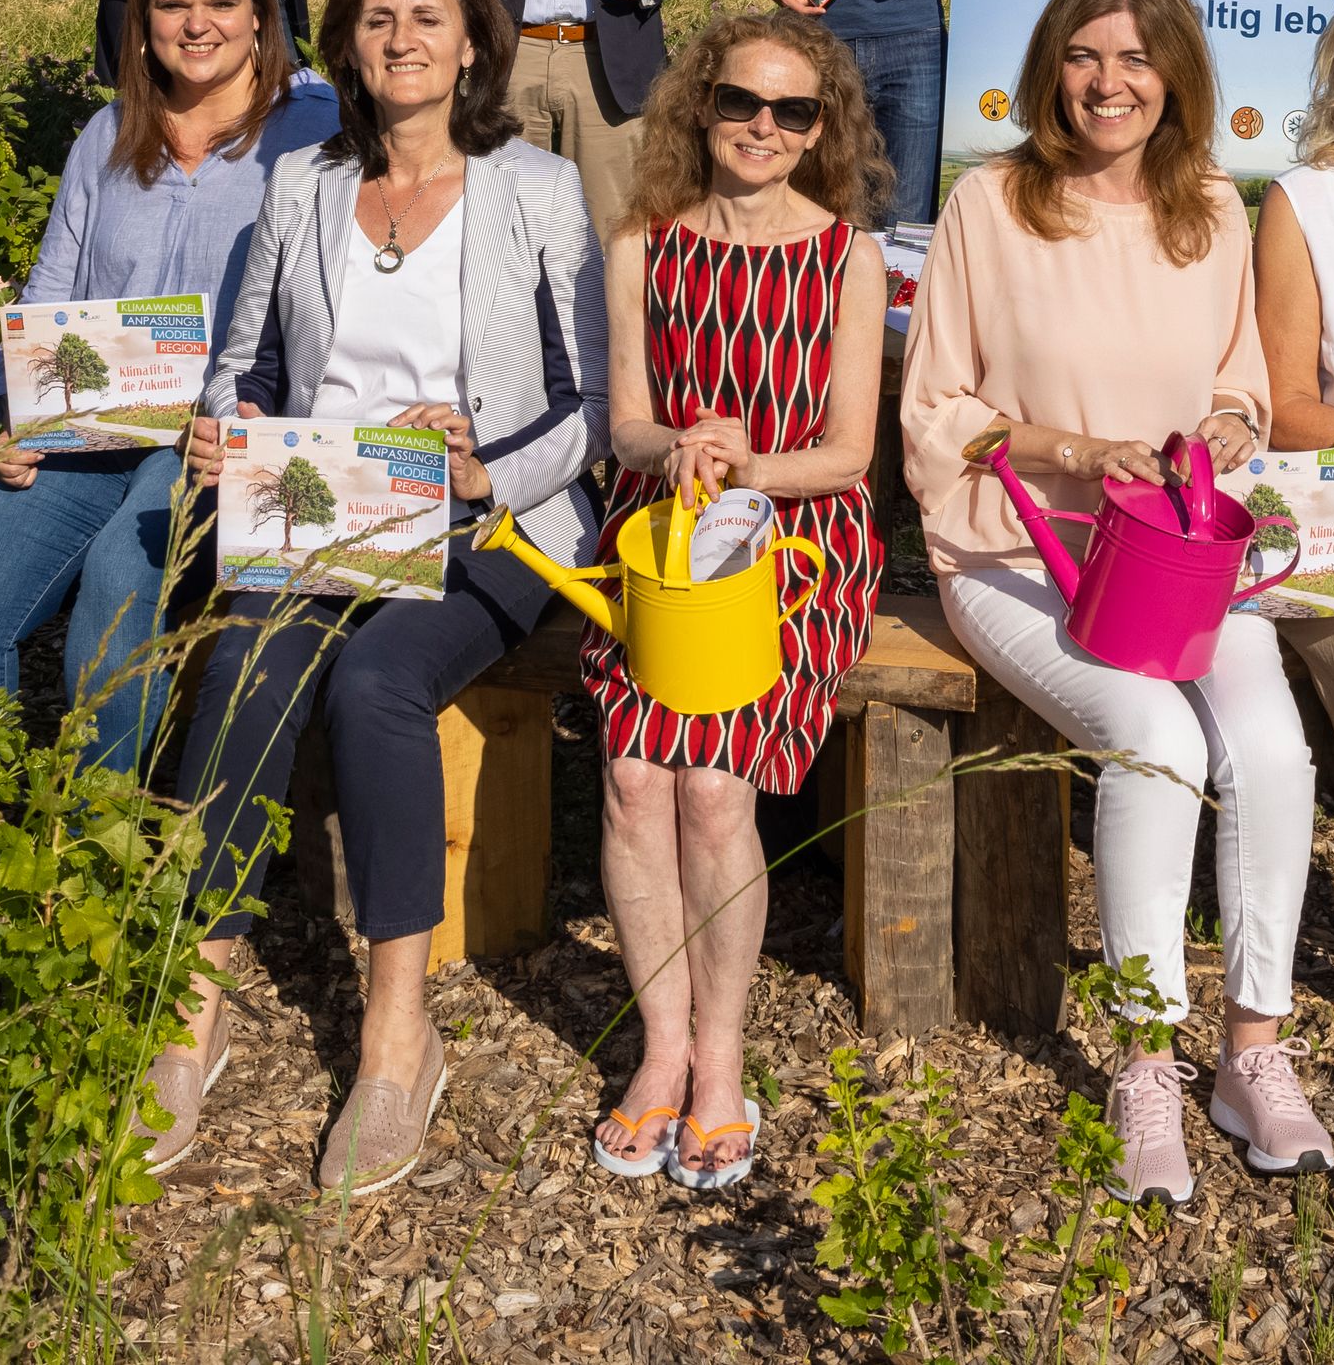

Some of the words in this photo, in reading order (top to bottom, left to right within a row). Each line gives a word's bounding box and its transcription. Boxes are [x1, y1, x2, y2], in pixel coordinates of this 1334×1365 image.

[1275, 4, 1327, 34] leb
[121, 302, 201, 314] KLIMAWANDEL-
[127, 315, 201, 326] ANPASSUNGS-
[155, 329, 201, 340] MODELL-
[160, 342, 201, 353] REGION
[119, 365, 161, 378] Klimafit
[164, 363, 173, 374] in
[121, 381, 136, 393] die
[138, 377, 181, 390] Zukunft!
[358, 429, 443, 451] KLIMAWANDEL-
[363, 446, 442, 466] ANPASSUNGS-
[391, 464, 441, 481] MODELL-
[396, 482, 438, 497] REGION
[347, 502, 393, 516] Klimafit
[396, 505, 406, 516] in
[347, 520, 363, 532] die
[699, 522, 712, 535] DIE
[715, 517, 758, 530] ZUKUNFT
[1309, 543, 1323, 556] die
